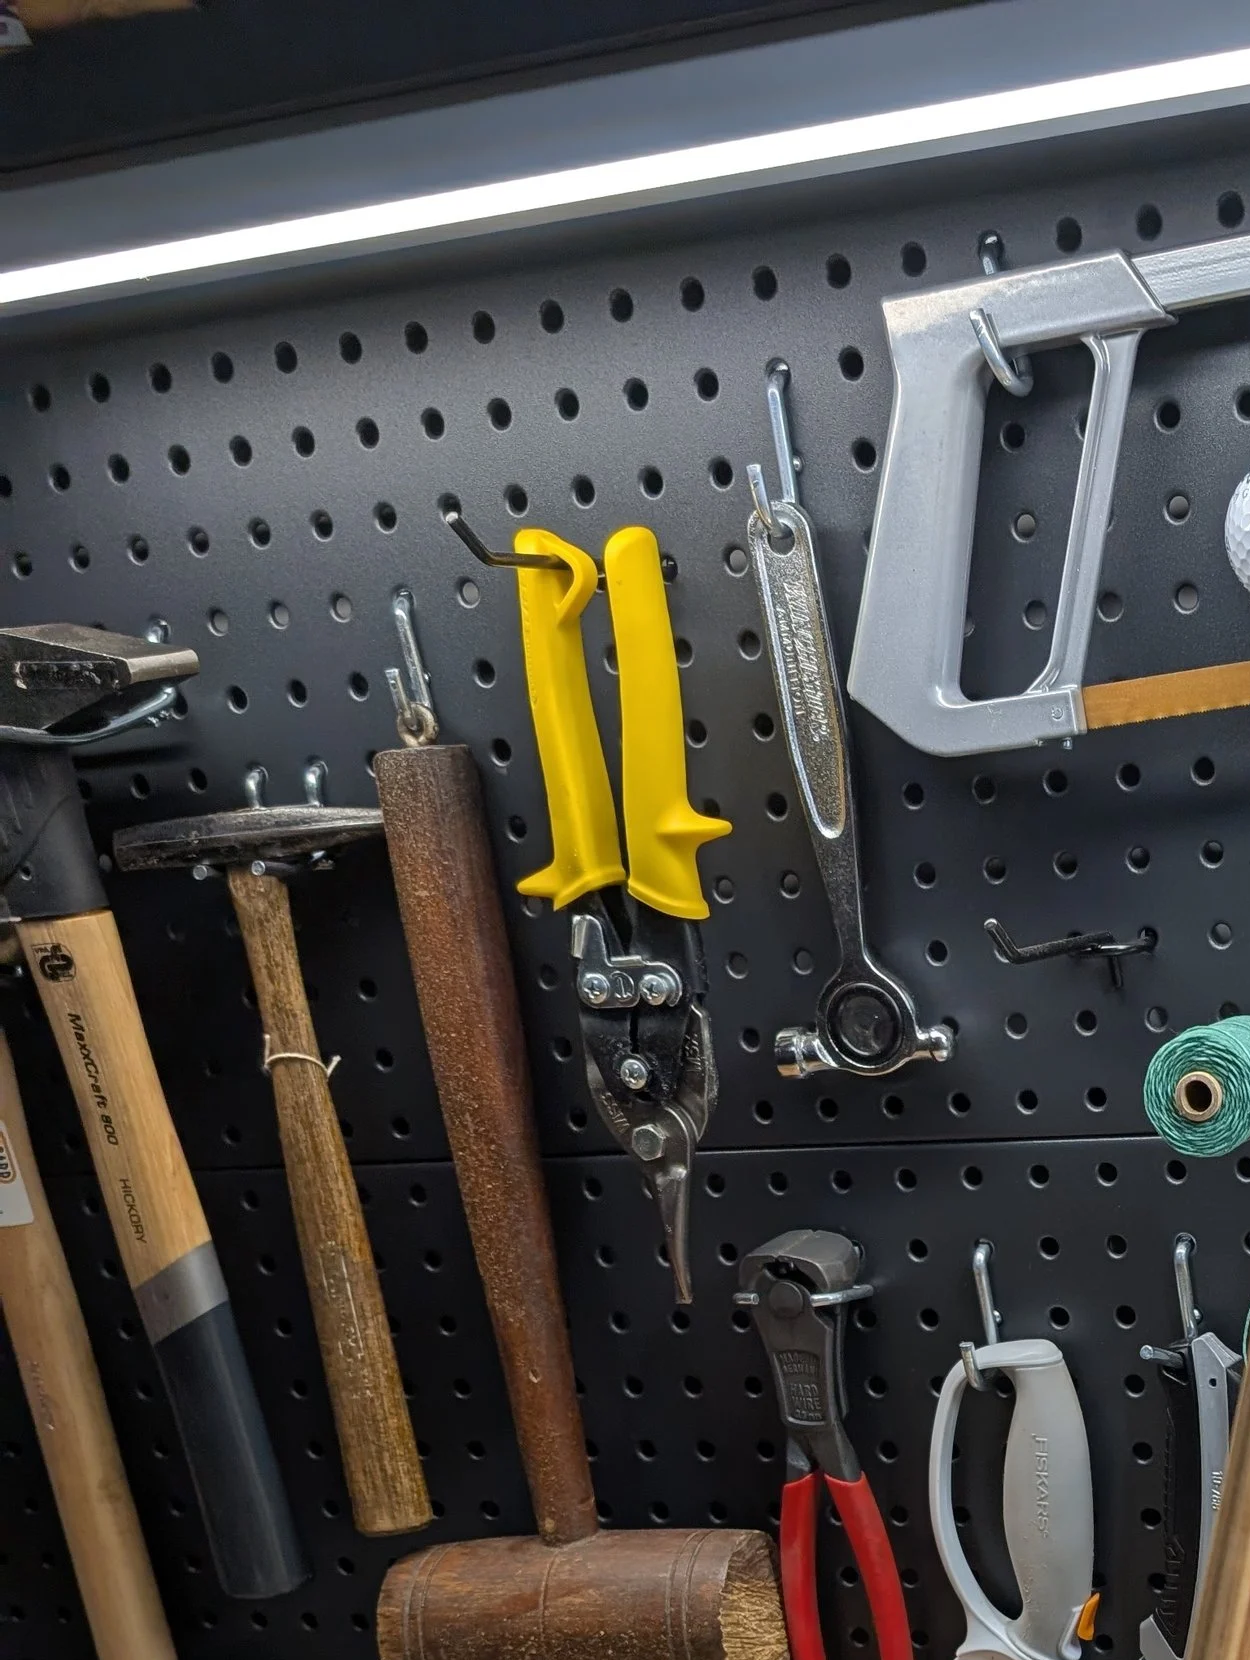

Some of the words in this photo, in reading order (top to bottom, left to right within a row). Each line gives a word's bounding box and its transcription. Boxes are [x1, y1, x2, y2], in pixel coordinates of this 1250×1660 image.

[67, 1012, 108, 1108] MaxxCraft
[101, 1114, 118, 1147] 800
[119, 1178, 147, 1244] HICKORY
[1033, 1433, 1051, 1531] FISKARS
